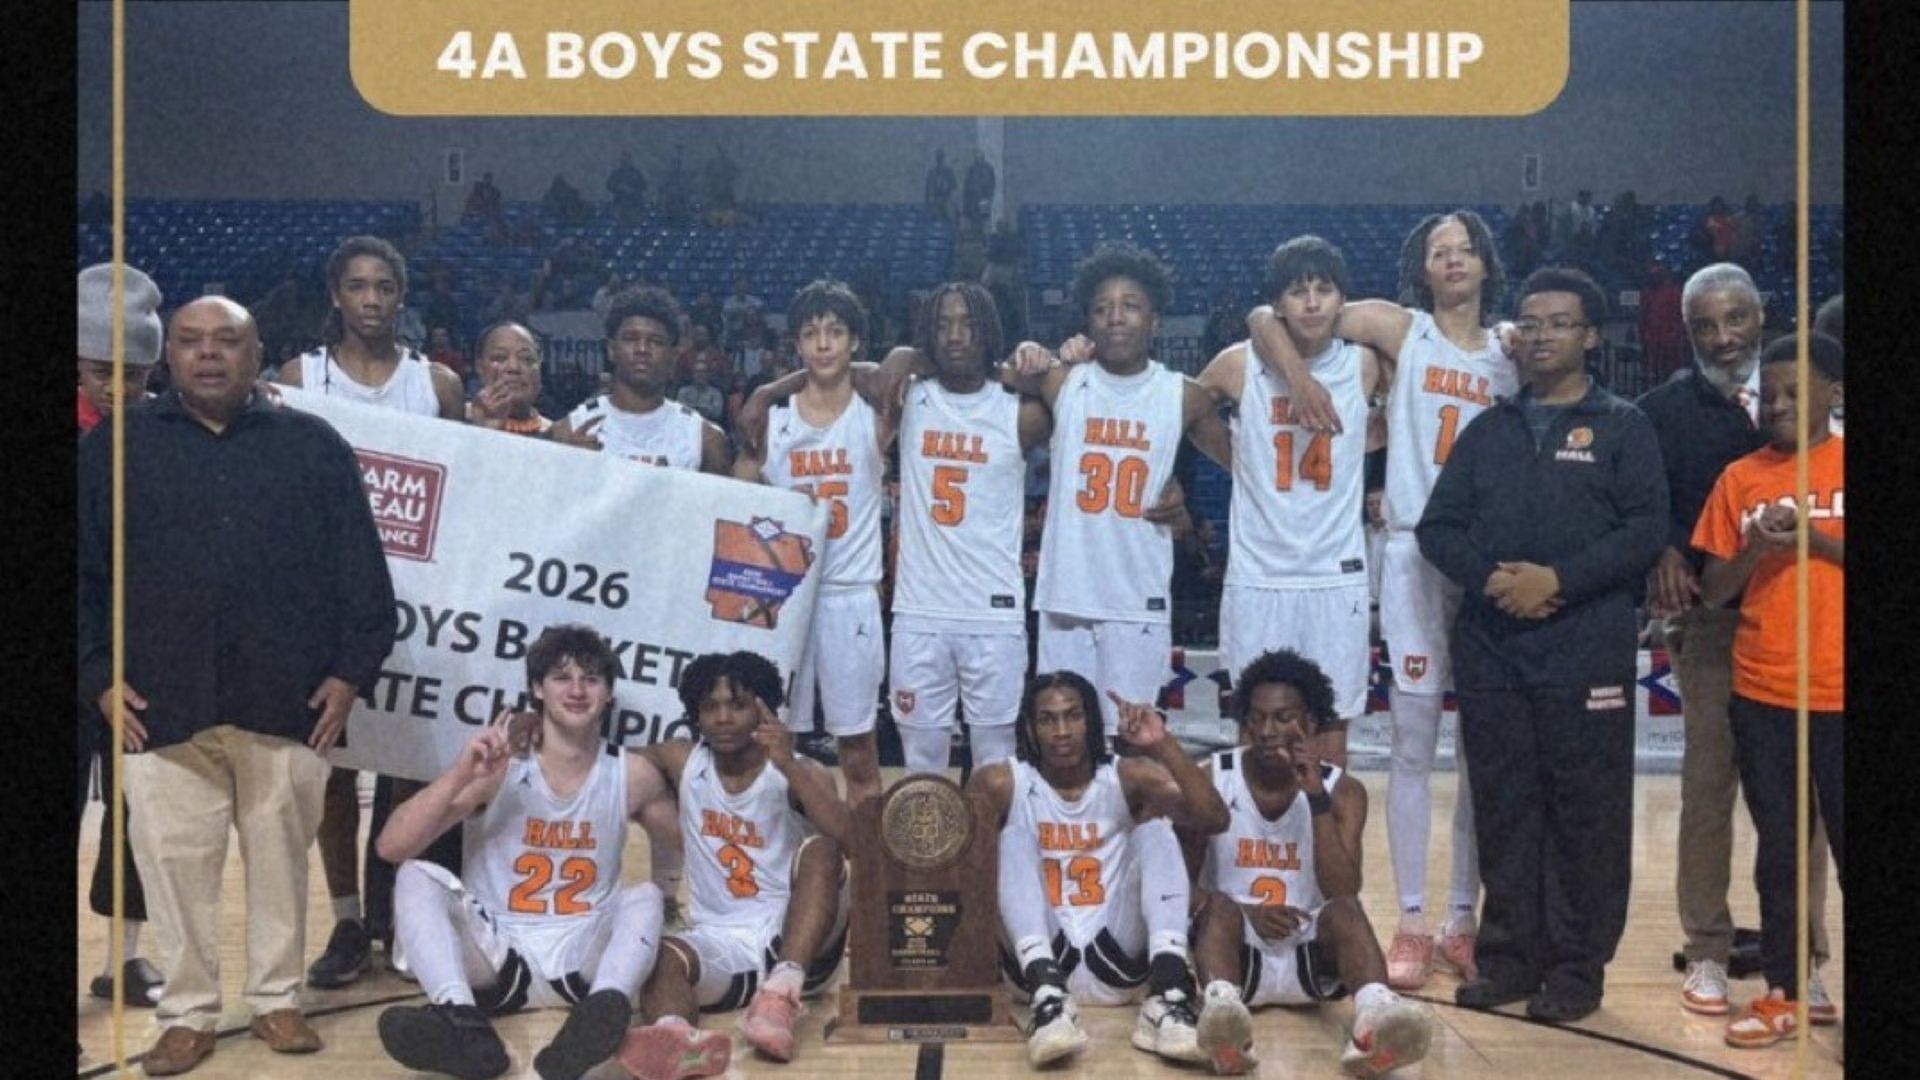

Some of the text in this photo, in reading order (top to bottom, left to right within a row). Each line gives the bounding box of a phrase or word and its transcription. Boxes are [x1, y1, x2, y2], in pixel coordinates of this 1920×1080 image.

[1422, 366, 1491, 407] HALL
[921, 430, 989, 463] HALL
[1083, 417, 1151, 451] HALL
[788, 449, 853, 477] HALL
[1274, 430, 1332, 492] 14
[1555, 450, 1596, 463] HALL
[360, 463, 427, 499] ARM
[930, 465, 969, 528] 5
[1075, 452, 1150, 519] 30
[368, 491, 427, 522] EAU
[790, 481, 849, 540] 5
[504, 551, 631, 611] 2026
[393, 600, 483, 655] OYS
[522, 817, 597, 850] HALL
[701, 809, 766, 849] HALL
[1037, 822, 1105, 851] HALL
[716, 844, 760, 898] 3
[1235, 837, 1302, 871] HALL
[508, 853, 598, 915] 22
[1041, 857, 1105, 908] 13
